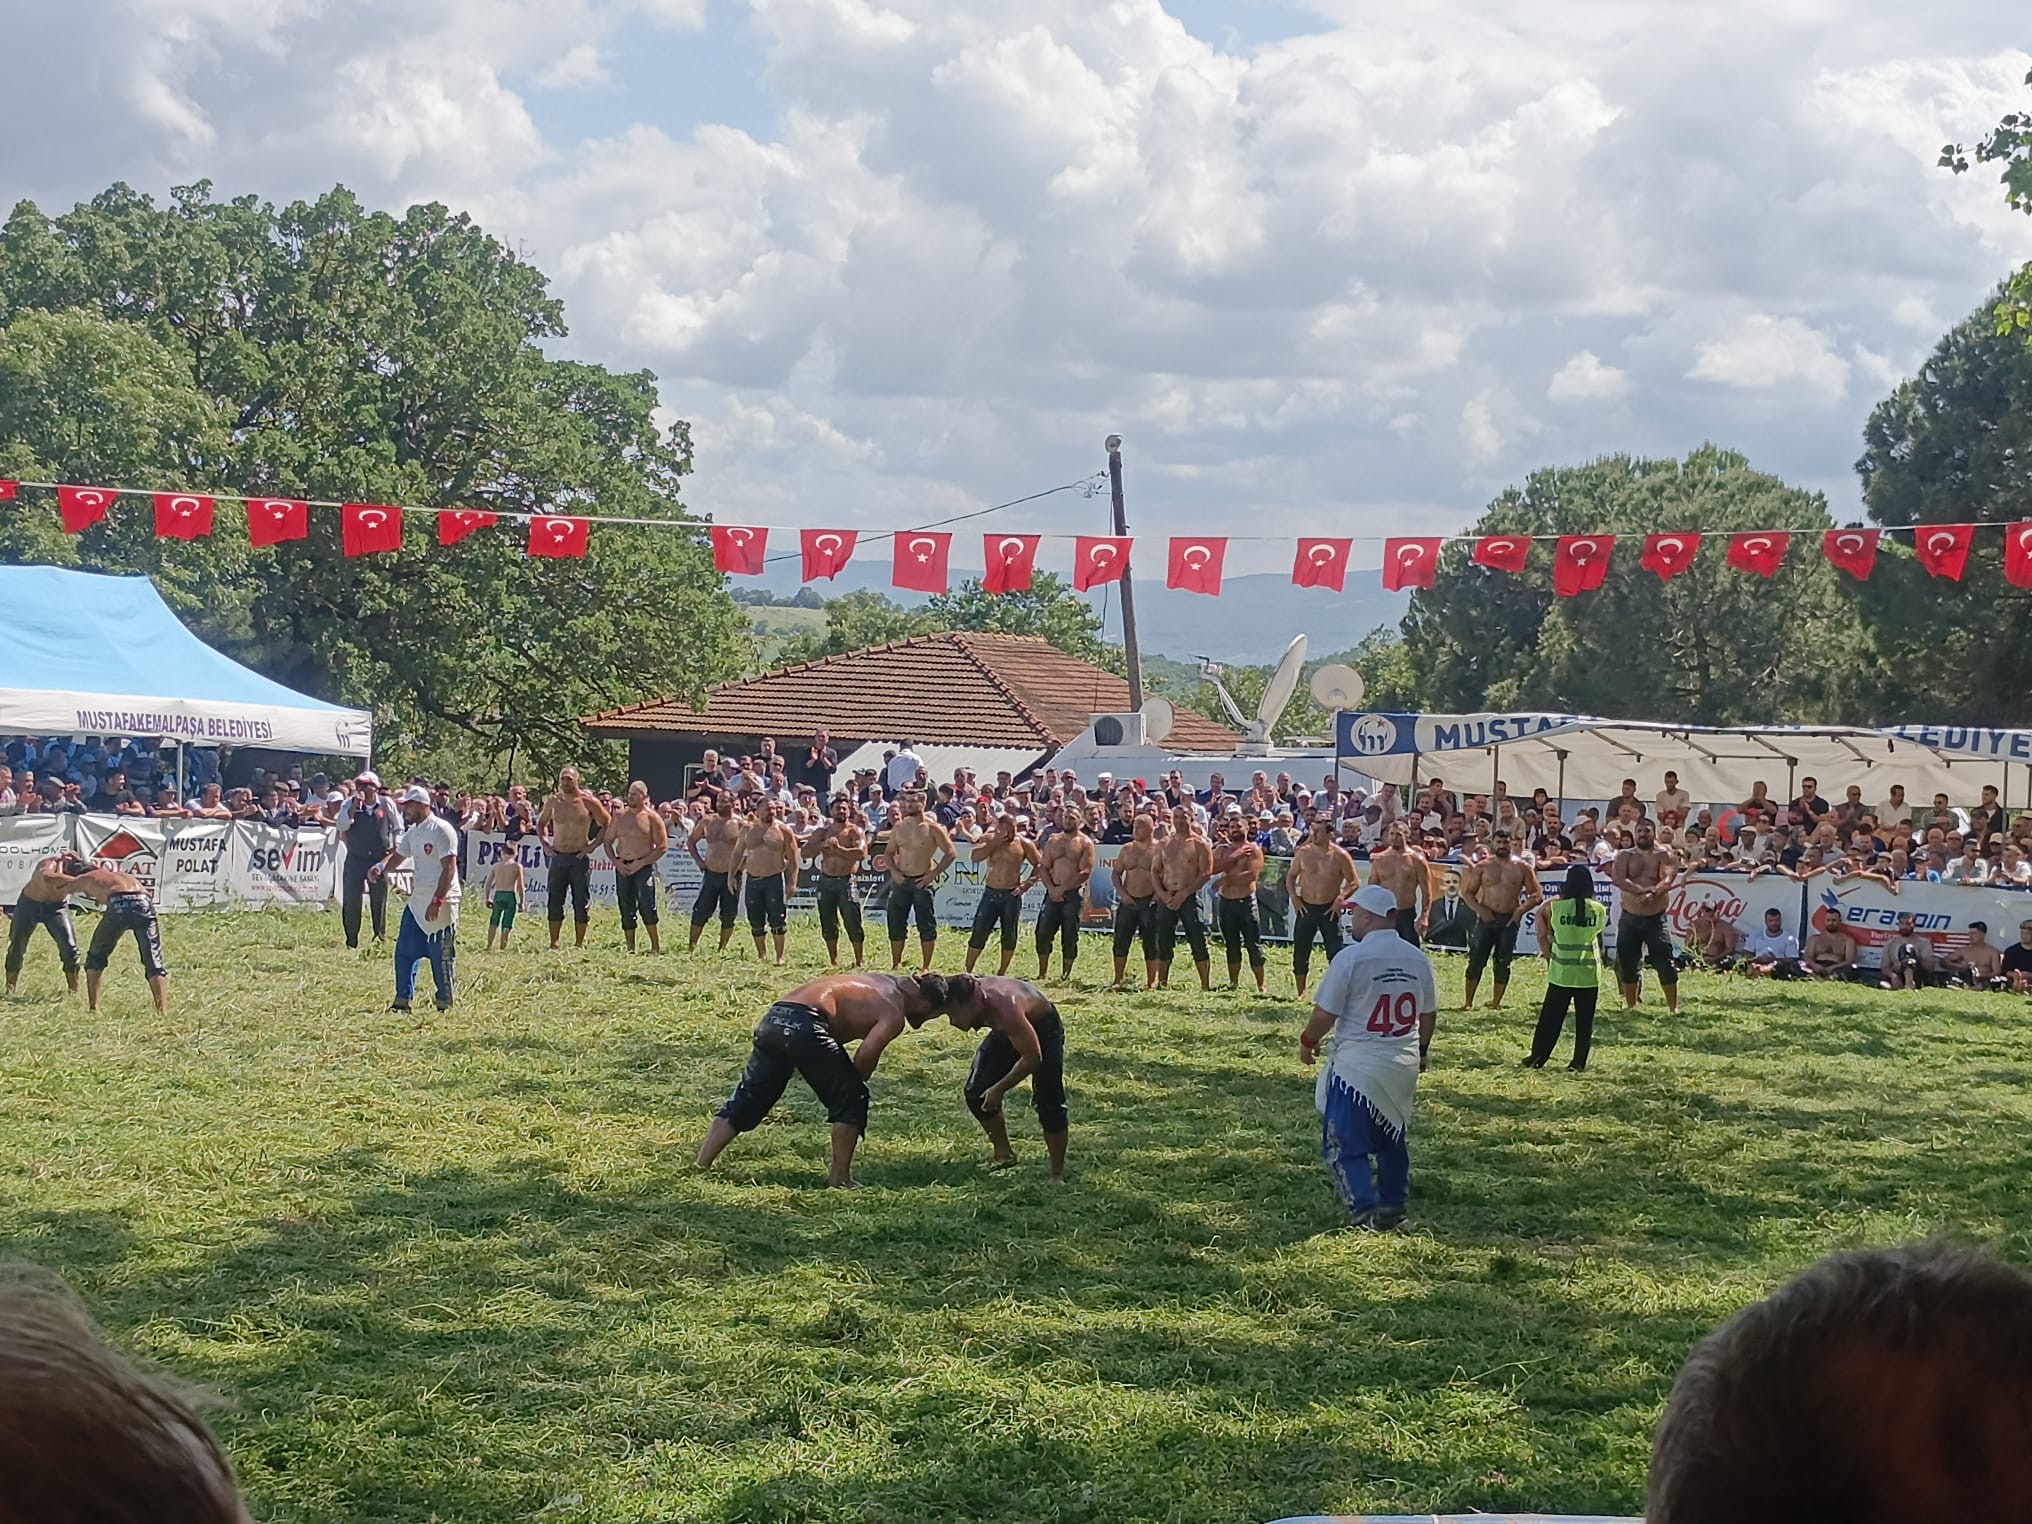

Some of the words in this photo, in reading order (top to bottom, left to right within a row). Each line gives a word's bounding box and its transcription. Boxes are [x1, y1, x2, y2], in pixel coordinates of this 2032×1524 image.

[77, 710, 205, 739] MUSTAFAKEMALPAŞA
[208, 716, 273, 739] BELEDİYESİ
[169, 837, 227, 851] MUSTAFA
[176, 858, 218, 873] POLAT
[253, 840, 321, 872] sevim
[90, 860, 156, 875] OLAT
[1366, 991, 1417, 1037] 49
